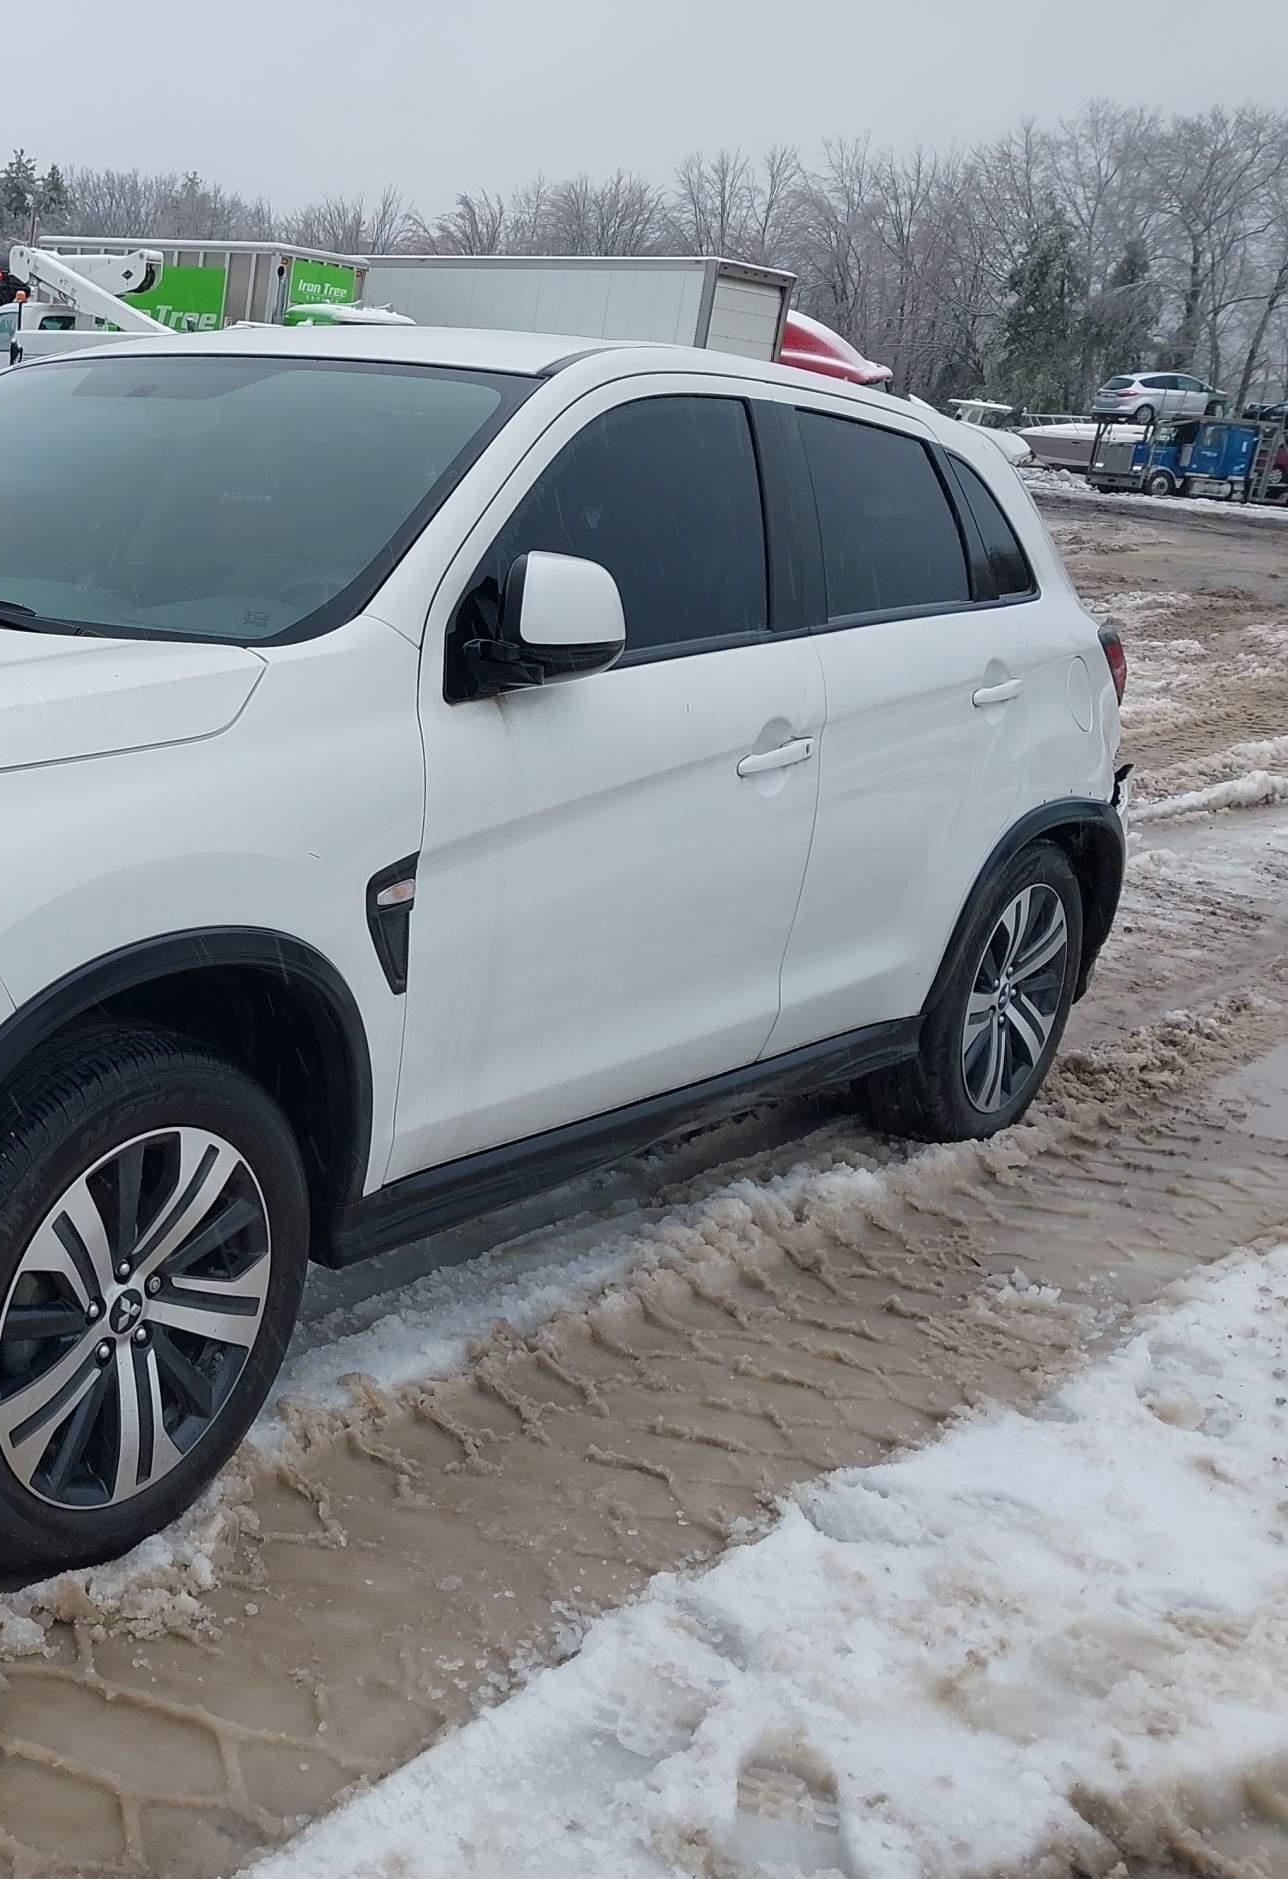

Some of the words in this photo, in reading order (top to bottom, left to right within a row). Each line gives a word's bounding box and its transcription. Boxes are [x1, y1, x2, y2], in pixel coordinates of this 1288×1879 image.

[298, 279, 321, 293] Iron
[324, 283, 348, 297] Tree
[156, 304, 218, 334] Tree
